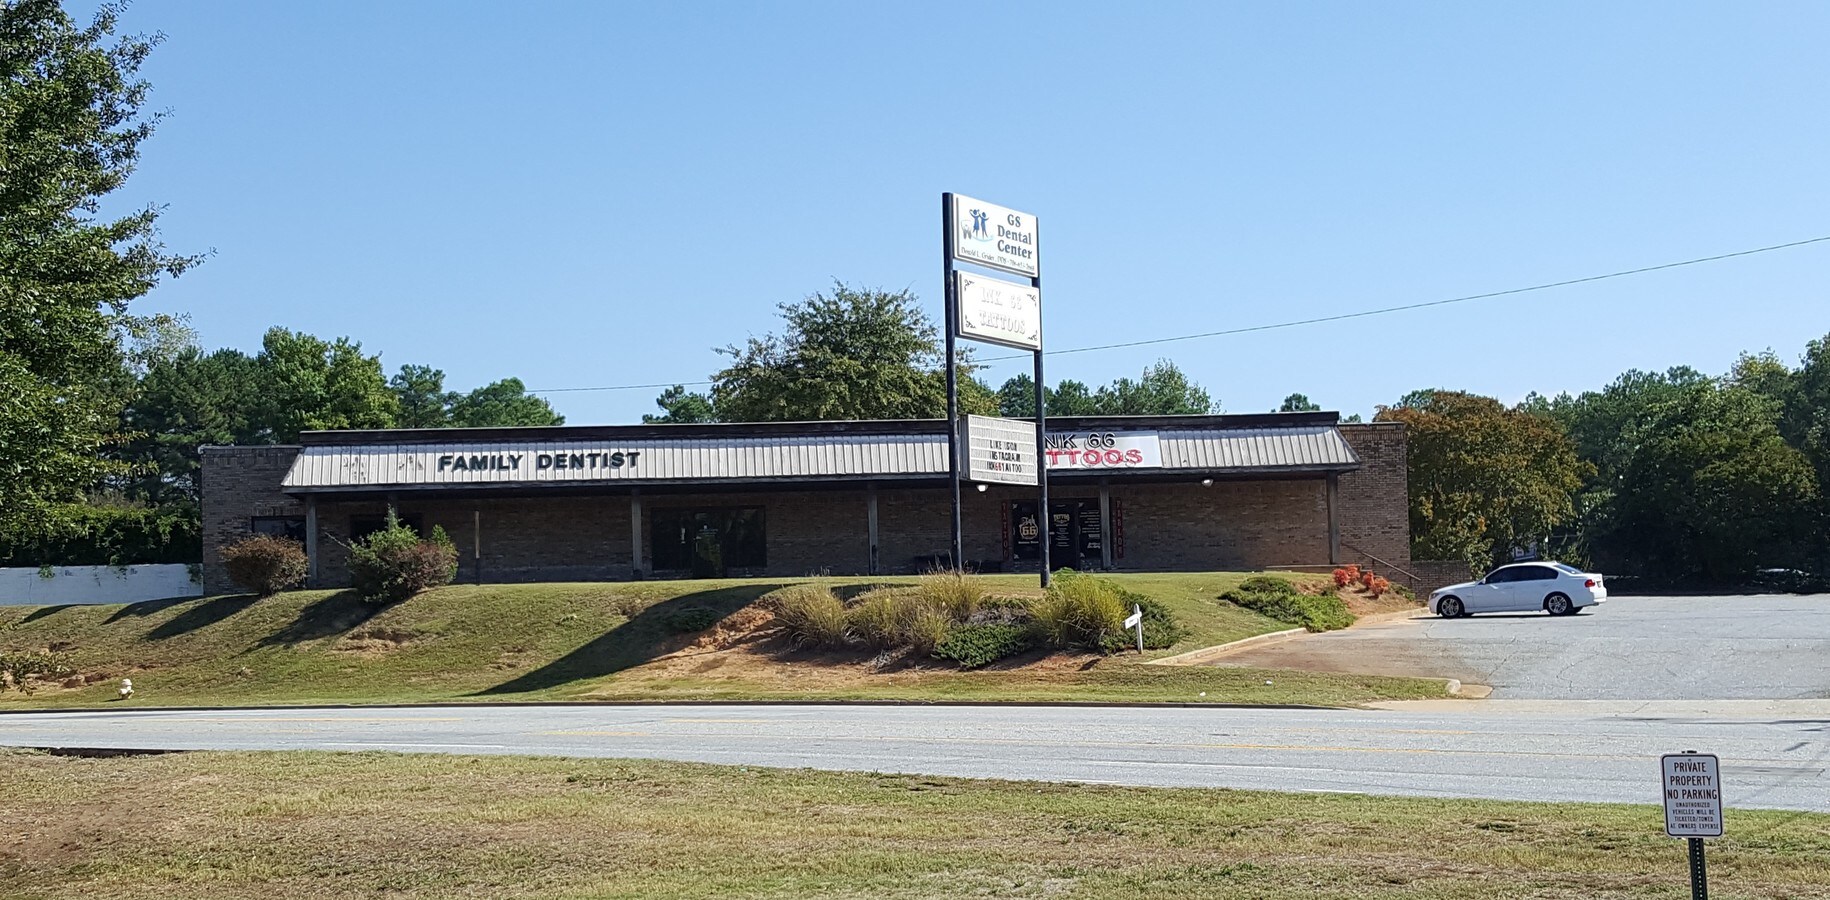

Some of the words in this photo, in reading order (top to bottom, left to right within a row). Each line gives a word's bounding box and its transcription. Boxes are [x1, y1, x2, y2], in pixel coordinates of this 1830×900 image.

[1007, 213, 1021, 228] GS
[997, 224, 1032, 246] Dental
[997, 239, 1032, 259] Center
[981, 287, 1003, 306] INK
[1010, 294, 1022, 310] 66
[979, 310, 1025, 335] TATTOOS
[990, 440, 1002, 450] LIKE
[1044, 432, 1077, 450] NK
[1086, 432, 1117, 450] 66
[438, 454, 523, 472] FAMILY
[537, 452, 640, 470] DENTIST
[990, 451, 1021, 462] INSTAGRAM
[1045, 448, 1143, 467] TTOOS
[1022, 526, 1036, 536] 66
[1674, 762, 1707, 773] PRIVATE
[1670, 776, 1712, 786] PROPERTY
[1667, 789, 1679, 800] NO
[1682, 789, 1717, 800] PARKING
